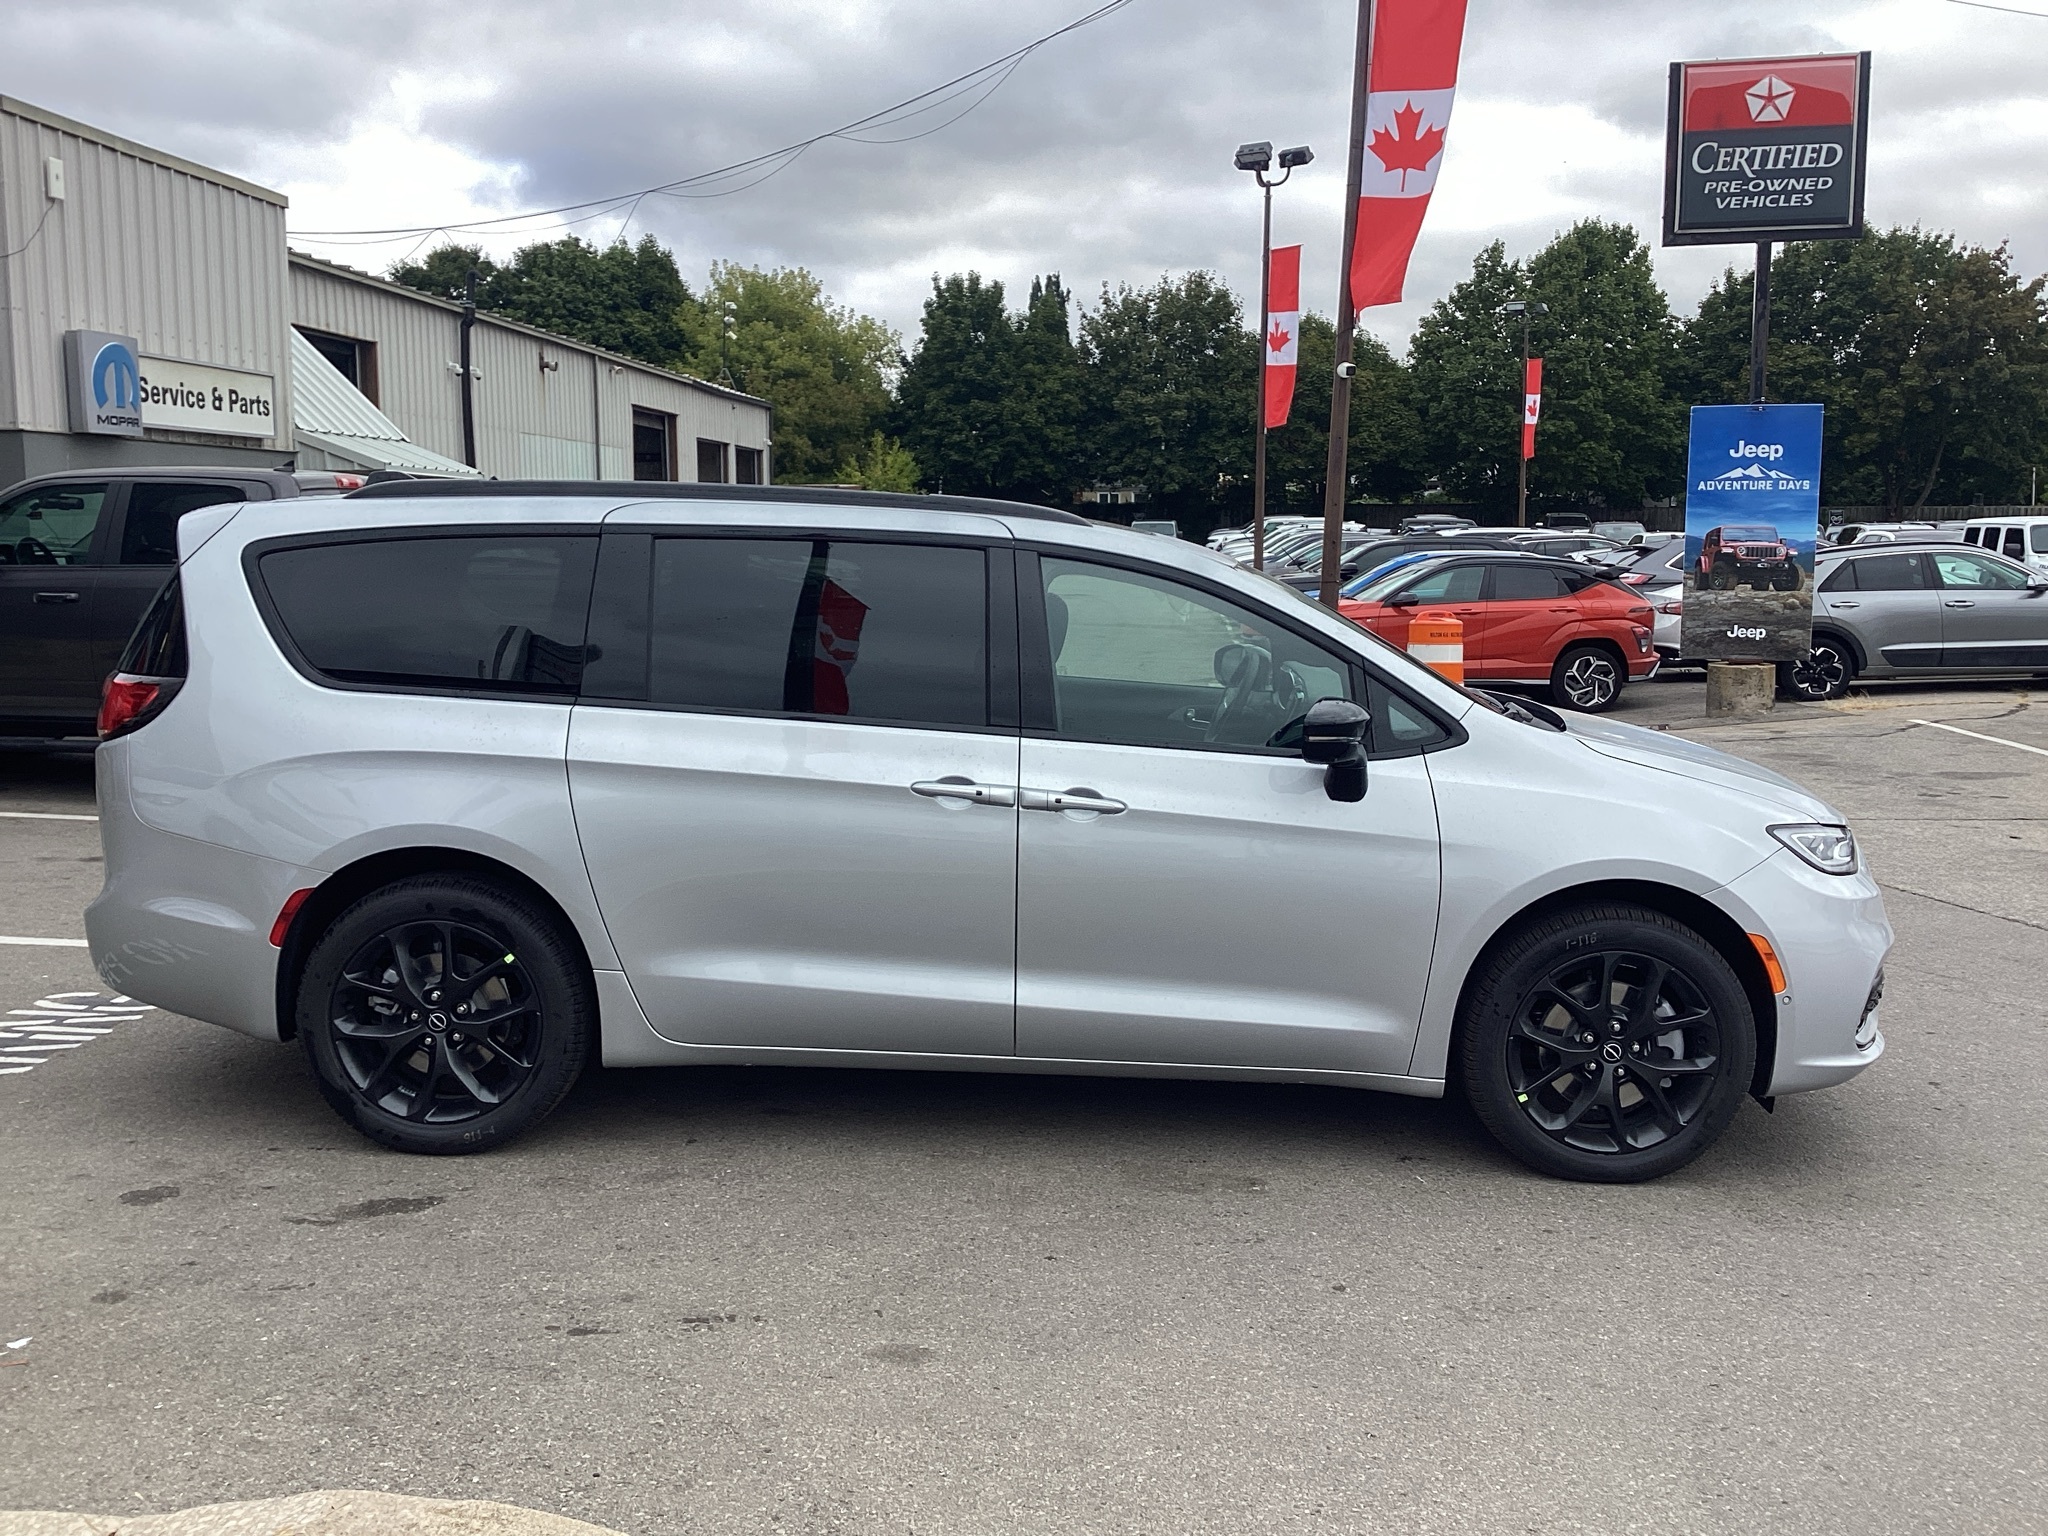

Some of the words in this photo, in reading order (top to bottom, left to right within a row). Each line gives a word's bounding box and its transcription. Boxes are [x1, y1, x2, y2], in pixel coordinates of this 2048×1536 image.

[1692, 142, 1843, 177] CERTIFIED
[1704, 177, 1833, 193] PRE-OWNED
[1716, 193, 1813, 209] VEHICLES
[140, 376, 205, 410] Service
[212, 386, 223, 411] &
[229, 388, 270, 417] Parts
[97, 414, 140, 428] MOPAR
[1729, 440, 1784, 461] Jeep
[1698, 480, 1773, 490] ADVENTURE
[1779, 480, 1810, 490] DAYS
[1726, 624, 1767, 641] Jeep
